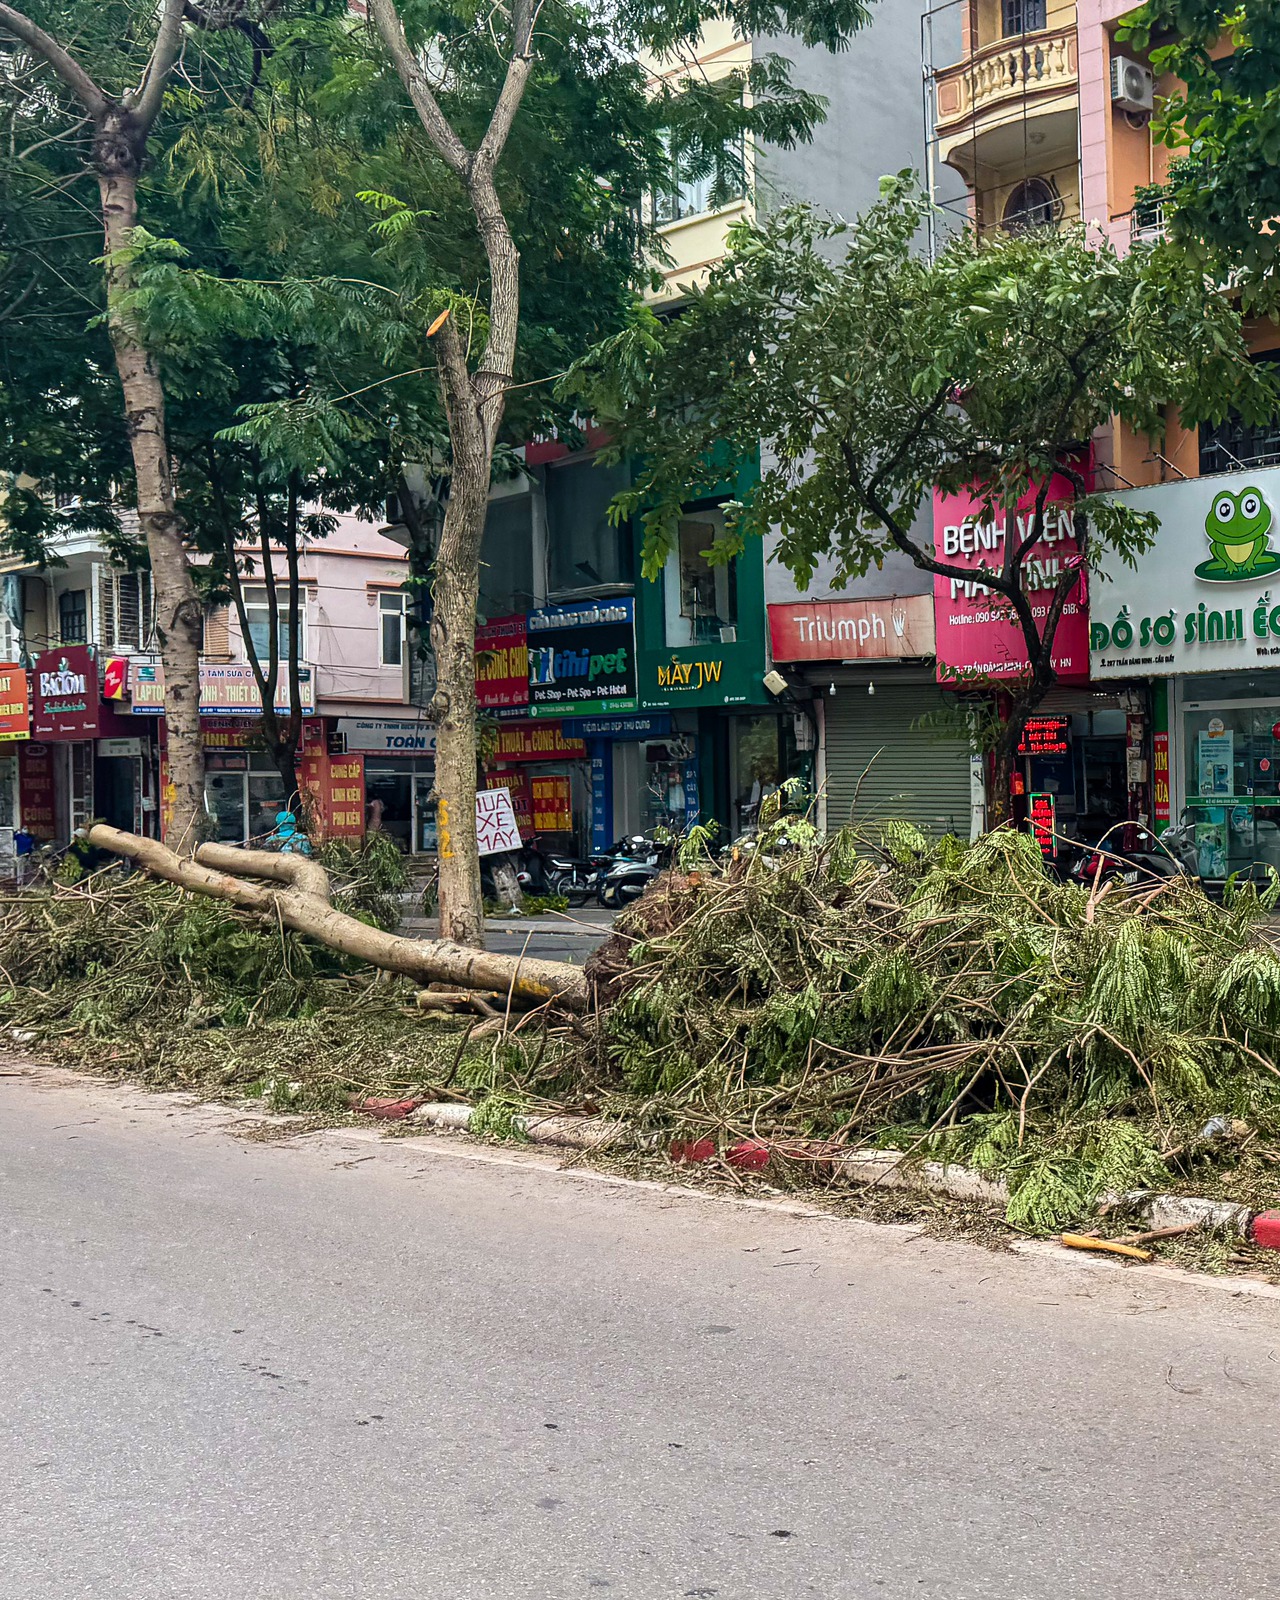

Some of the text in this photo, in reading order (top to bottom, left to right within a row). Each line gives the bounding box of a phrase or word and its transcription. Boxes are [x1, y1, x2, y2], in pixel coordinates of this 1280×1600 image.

[975, 612, 989, 624] 090
[1031, 607, 1046, 618] 093
[793, 613, 886, 647] Triumph
[1091, 604, 1134, 651] ĐỒ
[1140, 607, 1178, 647] SƠ
[1060, 658, 1072, 667] HN
[534, 690, 546, 701] Pet
[546, 690, 562, 701] Shop
[567, 688, 579, 699] Pet
[579, 688, 592, 698] Spa
[597, 686, 609, 697] Pet
[609, 685, 627, 695] Hotel
[386, 733, 426, 748] TOÀN
